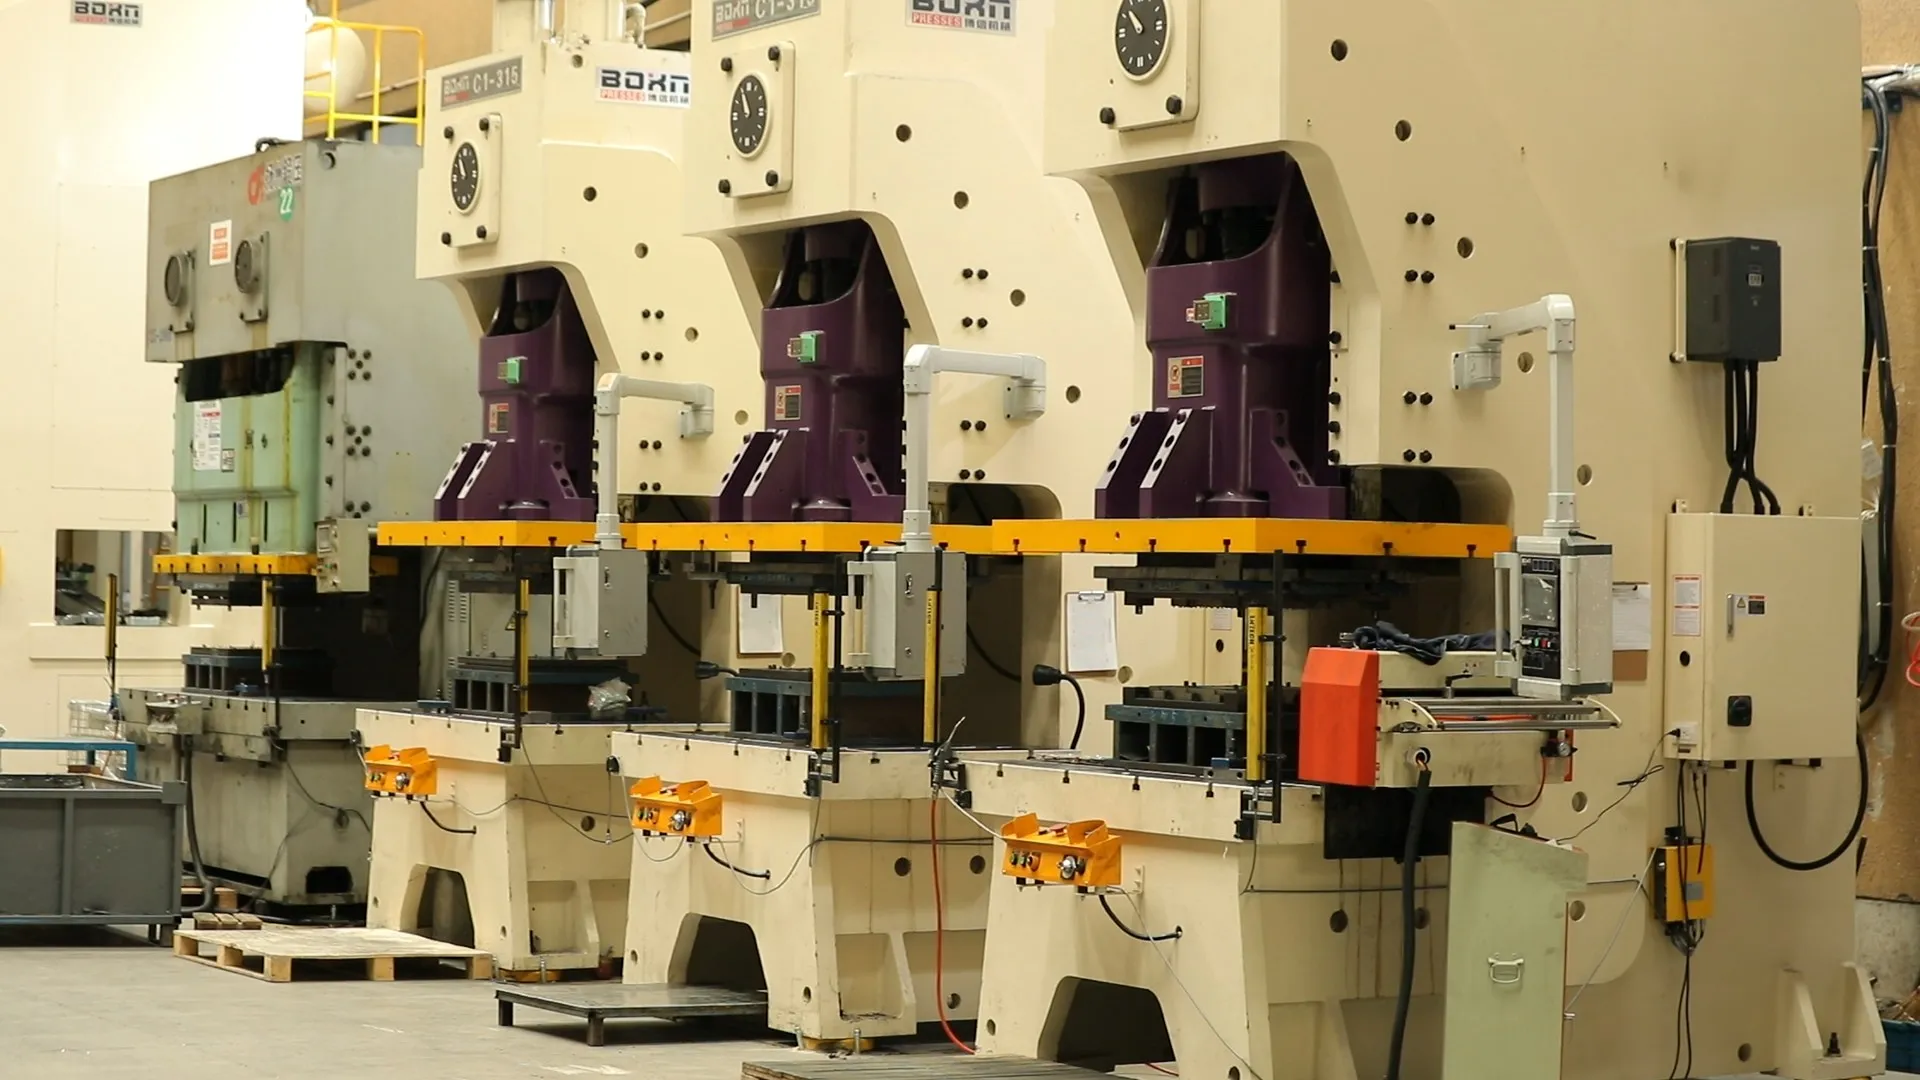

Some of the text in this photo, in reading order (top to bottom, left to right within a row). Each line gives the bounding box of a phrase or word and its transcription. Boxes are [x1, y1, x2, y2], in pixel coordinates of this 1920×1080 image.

[755, 0, 816, 19] C1-
[912, 12, 963, 28] PRESSES
[473, 65, 519, 94] C1-315
[601, 69, 690, 94] BOXN
[280, 186, 293, 215] 22
